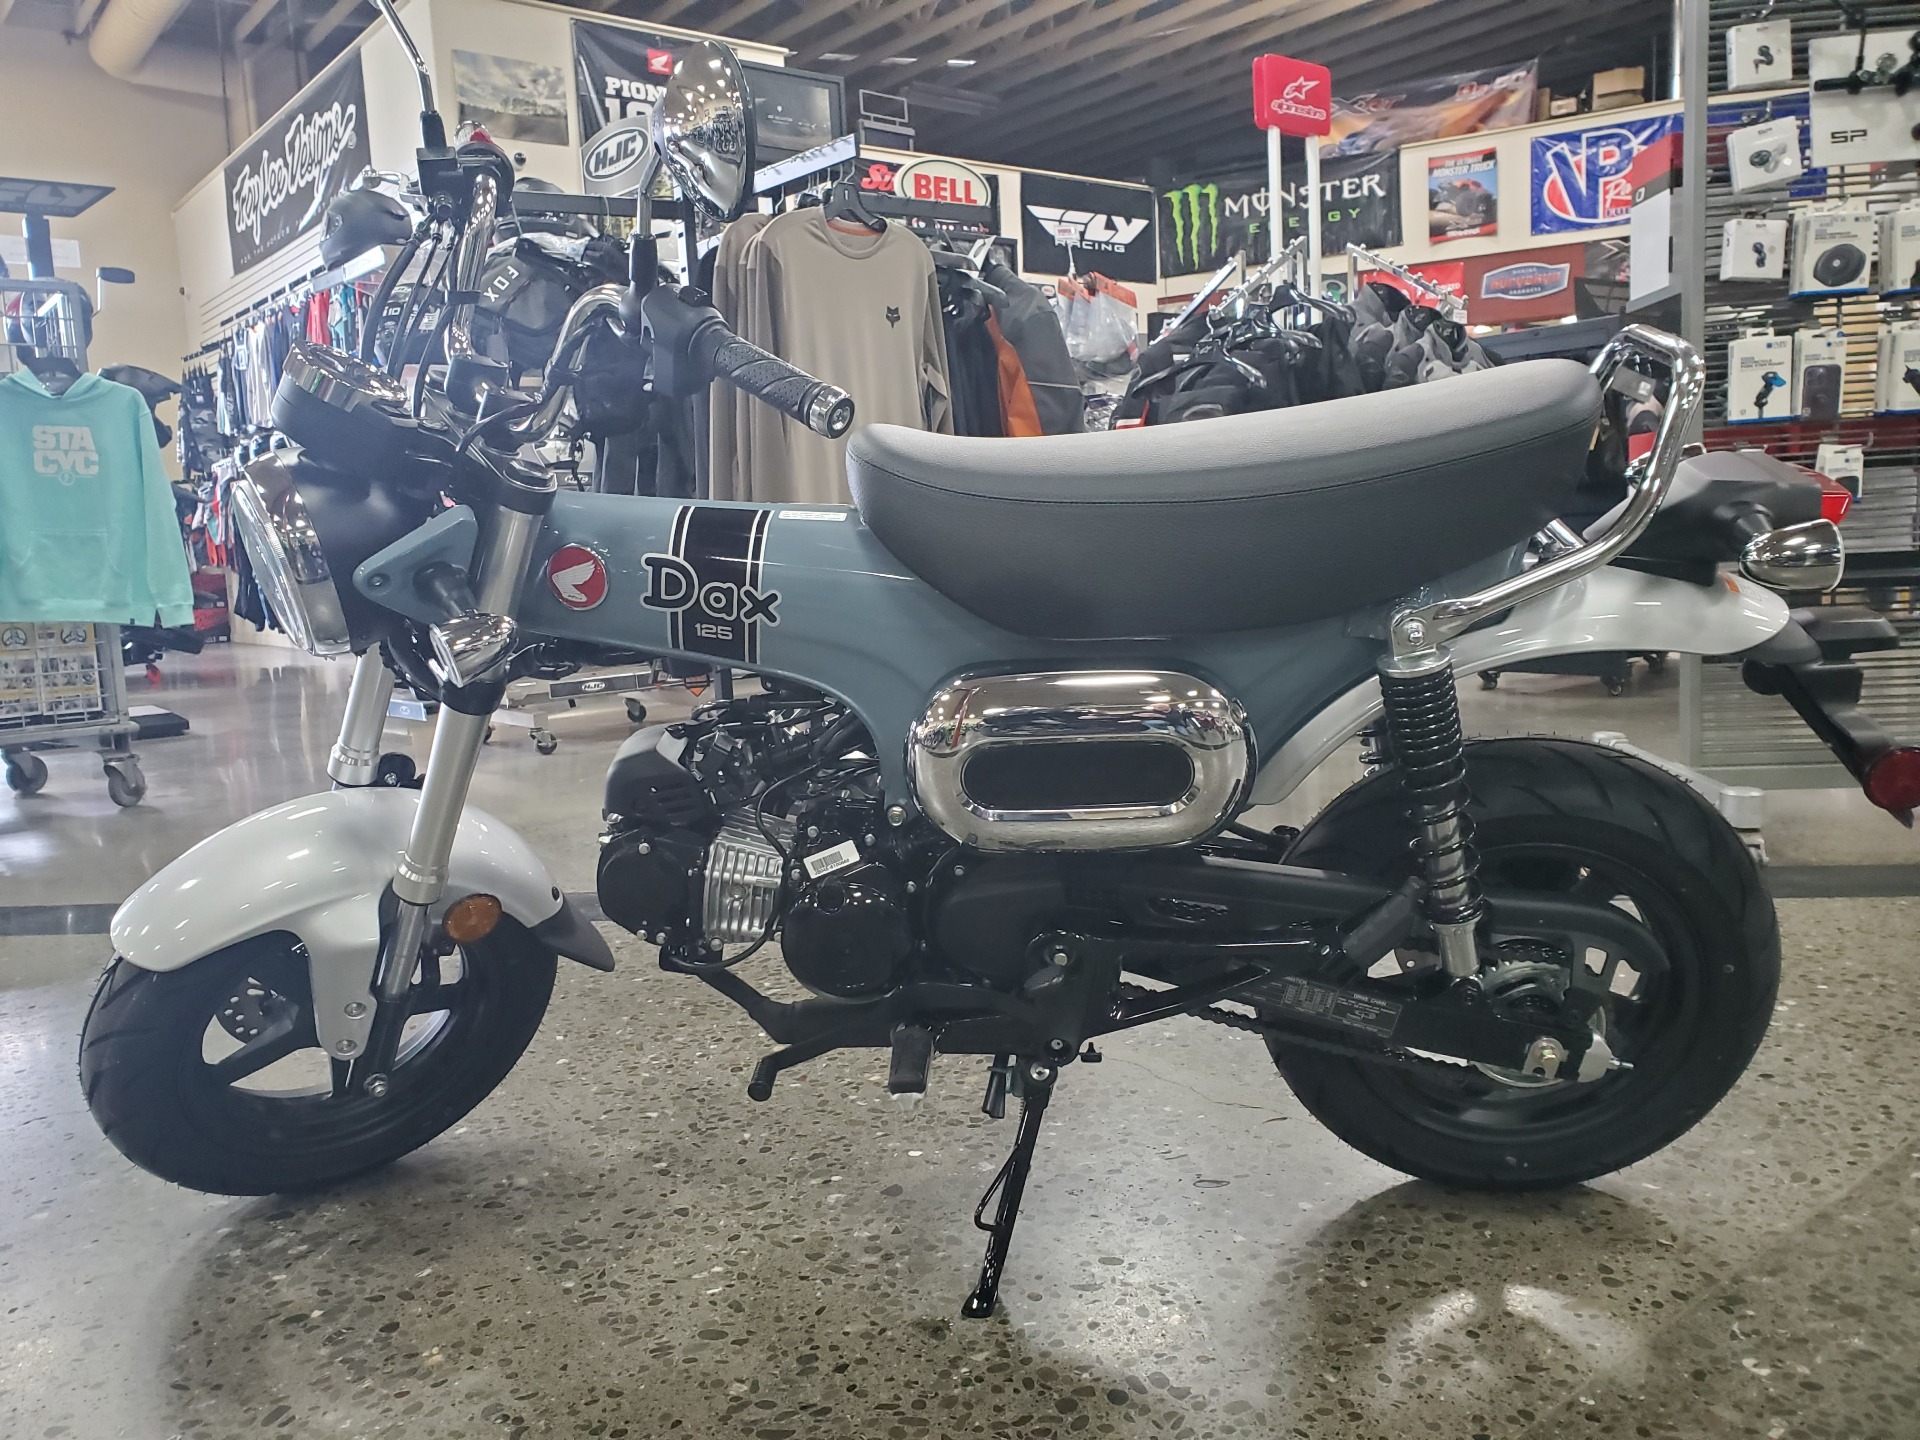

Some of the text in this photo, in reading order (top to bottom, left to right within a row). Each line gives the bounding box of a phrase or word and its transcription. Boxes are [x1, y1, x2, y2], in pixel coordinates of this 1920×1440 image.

[1271, 99, 1326, 120] alpinestars
[1831, 129, 1867, 144] SP
[594, 133, 638, 173] HJC
[1546, 128, 1635, 219] VP
[914, 173, 977, 204] BELL
[1224, 174, 1386, 220] MONSTER
[1026, 204, 1150, 245] FLY
[1249, 208, 1360, 235] EEGY
[1055, 239, 1126, 253] RACING
[483, 266, 519, 303] FOX
[33, 425, 95, 450] STA
[34, 451, 99, 474] CYC
[640, 553, 782, 627] Dax
[695, 623, 733, 640] 125
